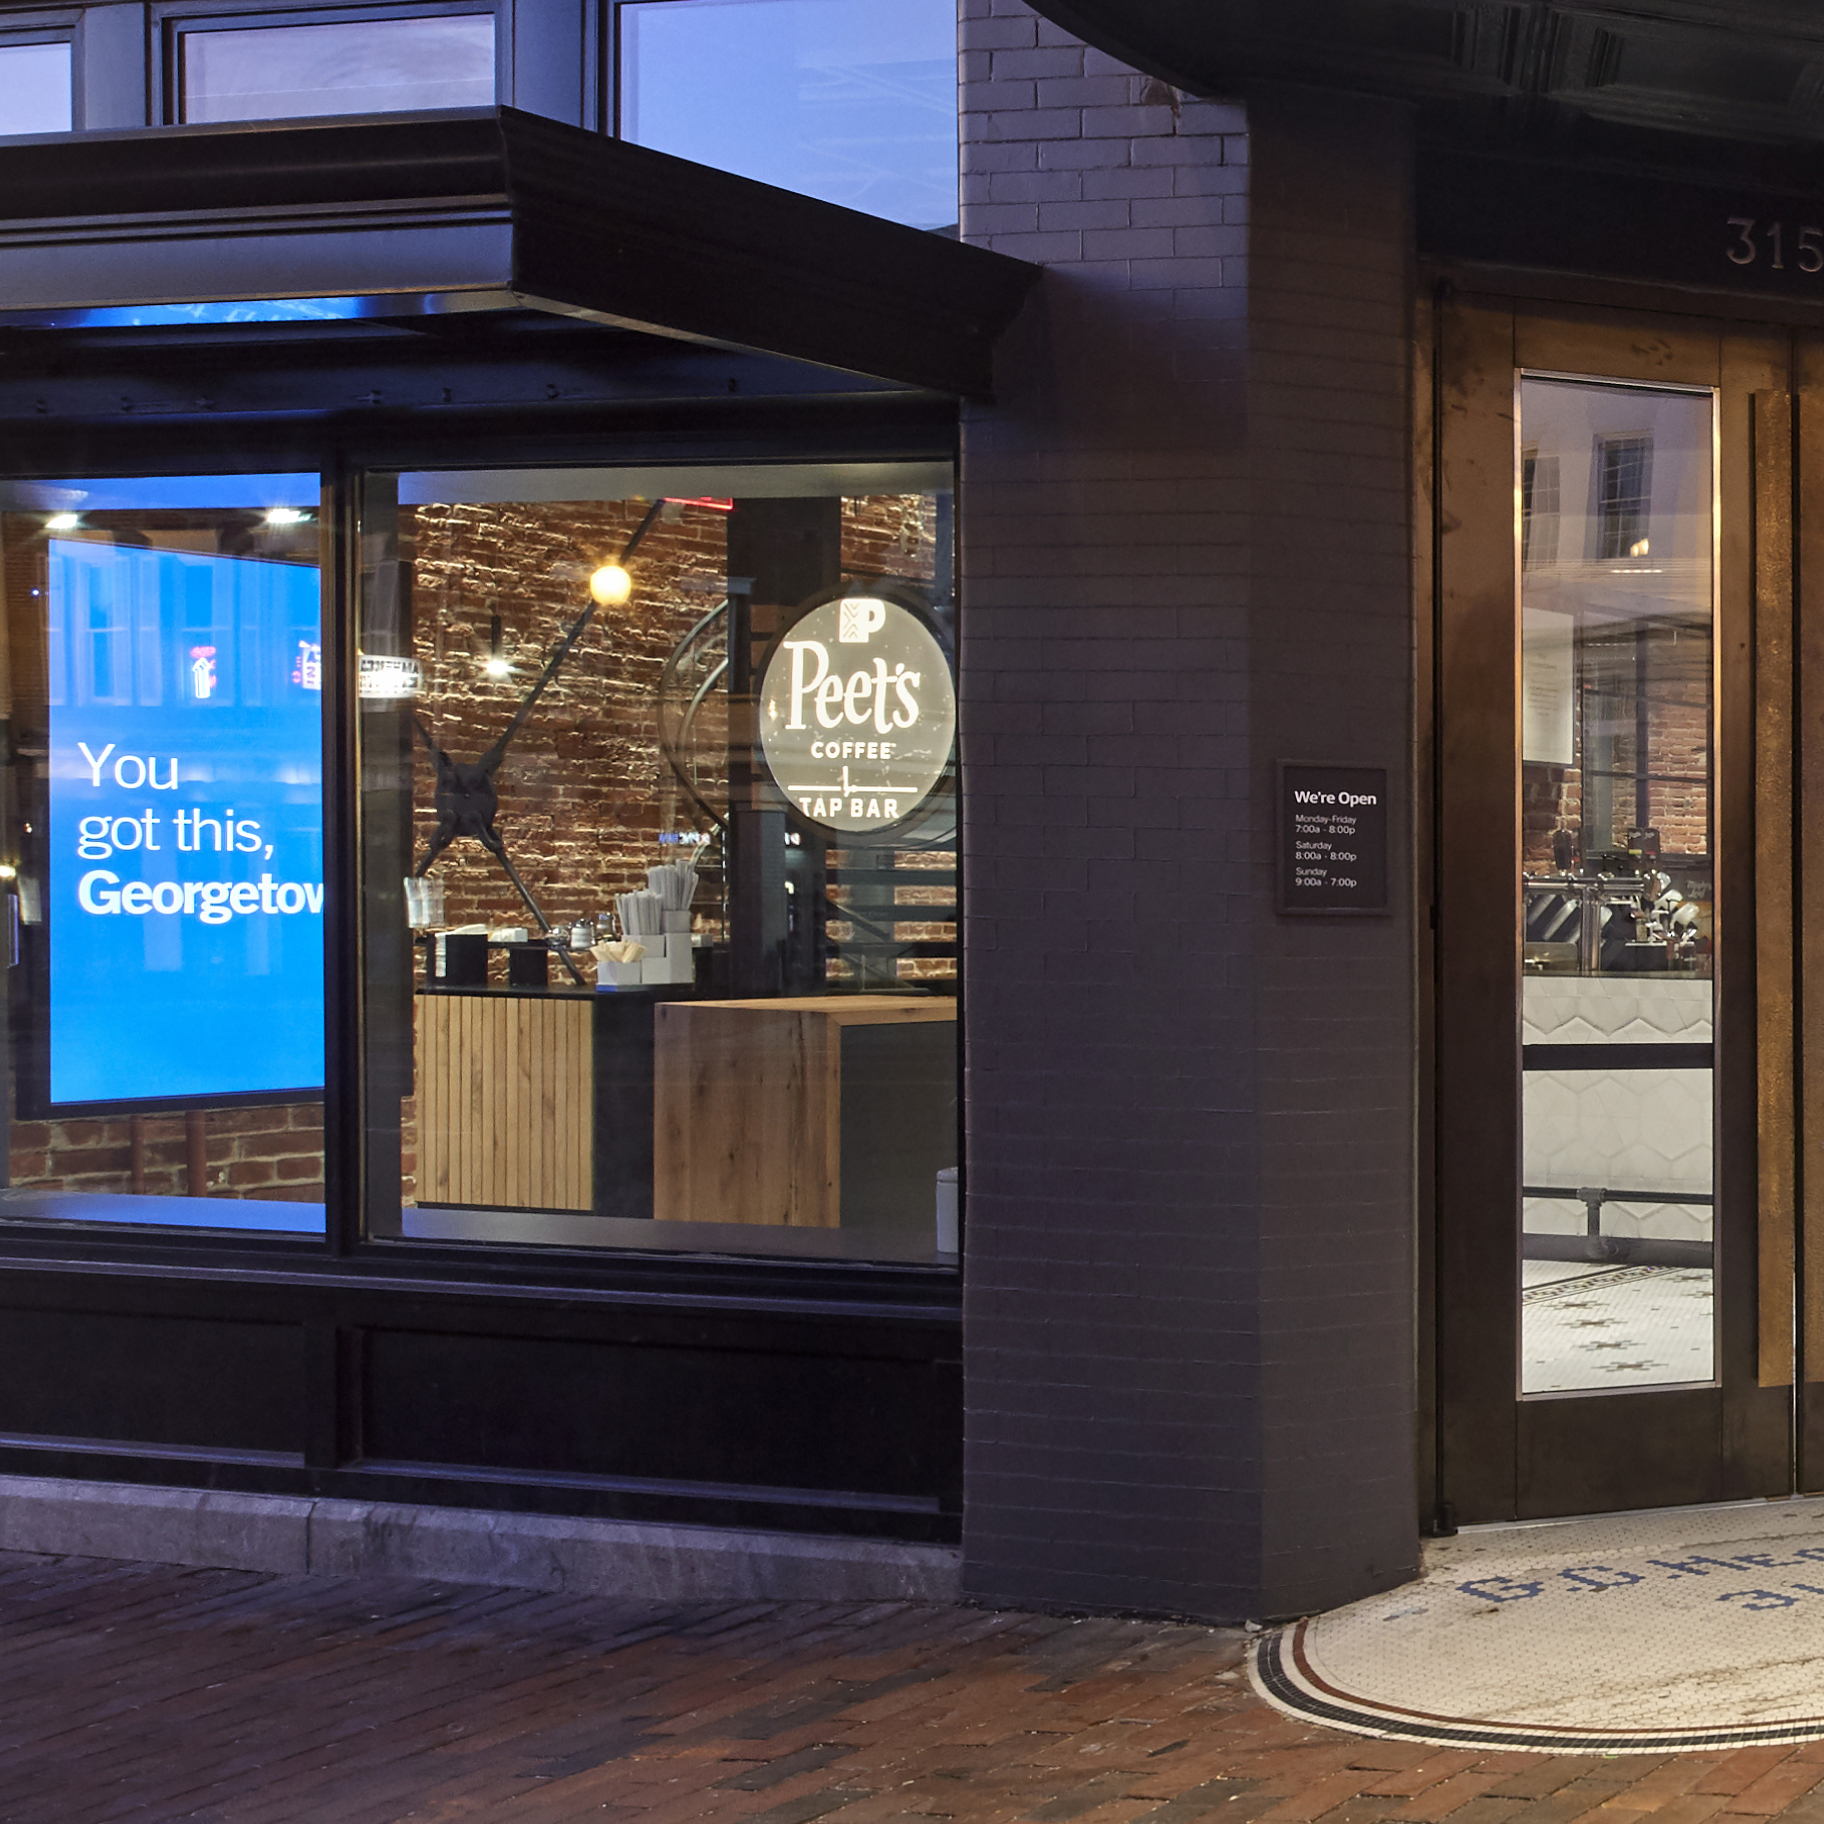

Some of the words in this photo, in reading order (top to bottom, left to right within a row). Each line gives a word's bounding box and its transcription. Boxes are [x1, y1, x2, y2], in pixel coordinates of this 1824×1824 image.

[783, 640, 921, 734] Peet's
[811, 741, 892, 759] COFFEE
[78, 742, 178, 790] You
[1294, 790, 1335, 804] We're
[1338, 791, 1377, 808] Open
[799, 798, 843, 818] TAP
[850, 798, 899, 819] BAR
[1295, 814, 1356, 825] Monday-Friday
[77, 808, 160, 860] got
[172, 808, 274, 860] this,
[1328, 825, 1356, 835] 8:00p
[1295, 840, 1333, 851] Saturday
[1295, 851, 1322, 860] 8:00a
[1330, 852, 1357, 862] 8:00p
[1296, 866, 1328, 877] Sunday
[1295, 877, 1322, 887] 9:00a
[1331, 877, 1357, 888] 7:00p
